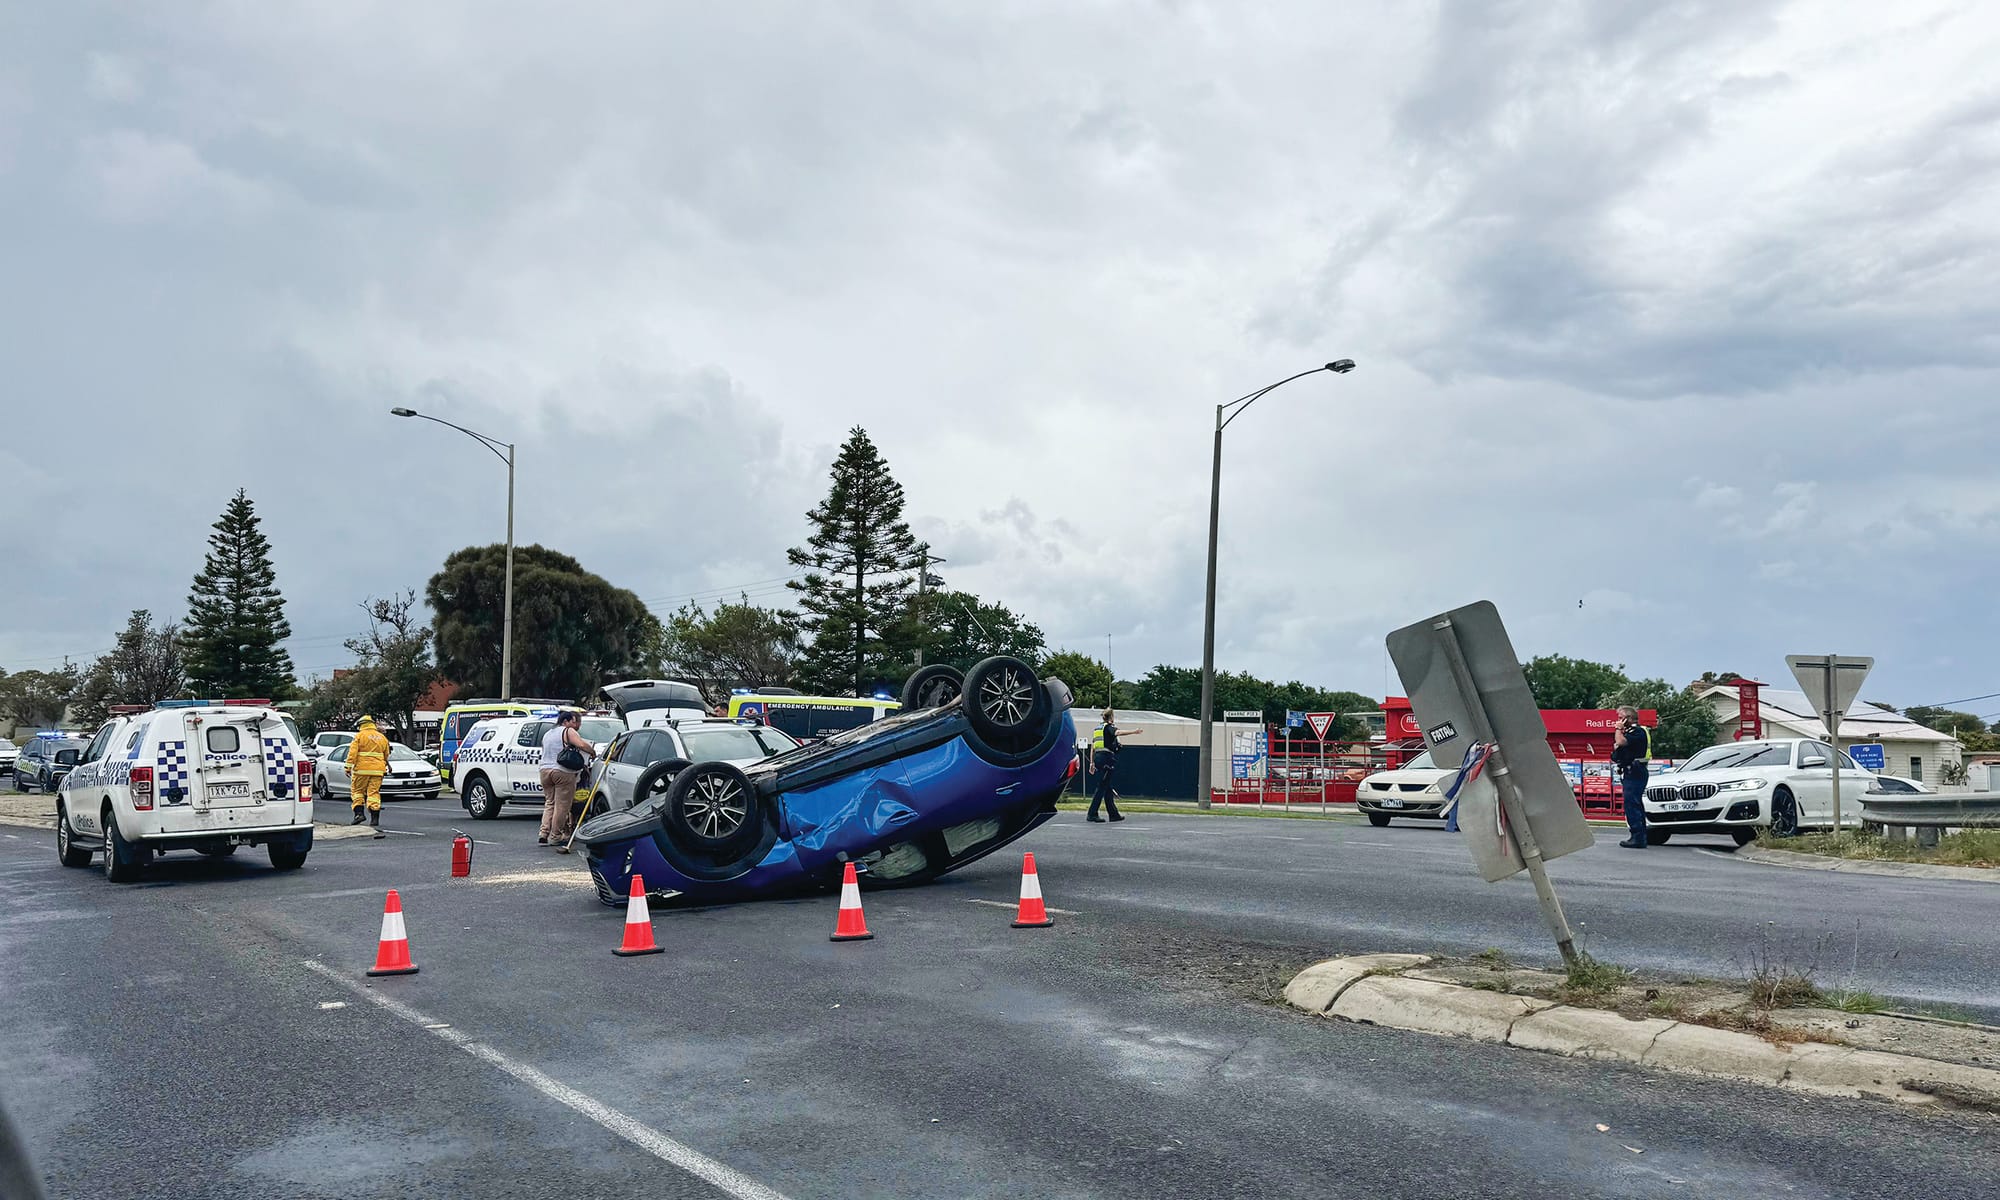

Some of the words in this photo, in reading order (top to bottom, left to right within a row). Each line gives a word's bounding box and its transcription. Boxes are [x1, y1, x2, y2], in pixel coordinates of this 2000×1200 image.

[1586, 719, 1604, 727] Real
[1605, 719, 1618, 728] Es
[1430, 725, 1454, 743] FATAL
[204, 753, 248, 761] Police
[512, 781, 543, 792] Polic
